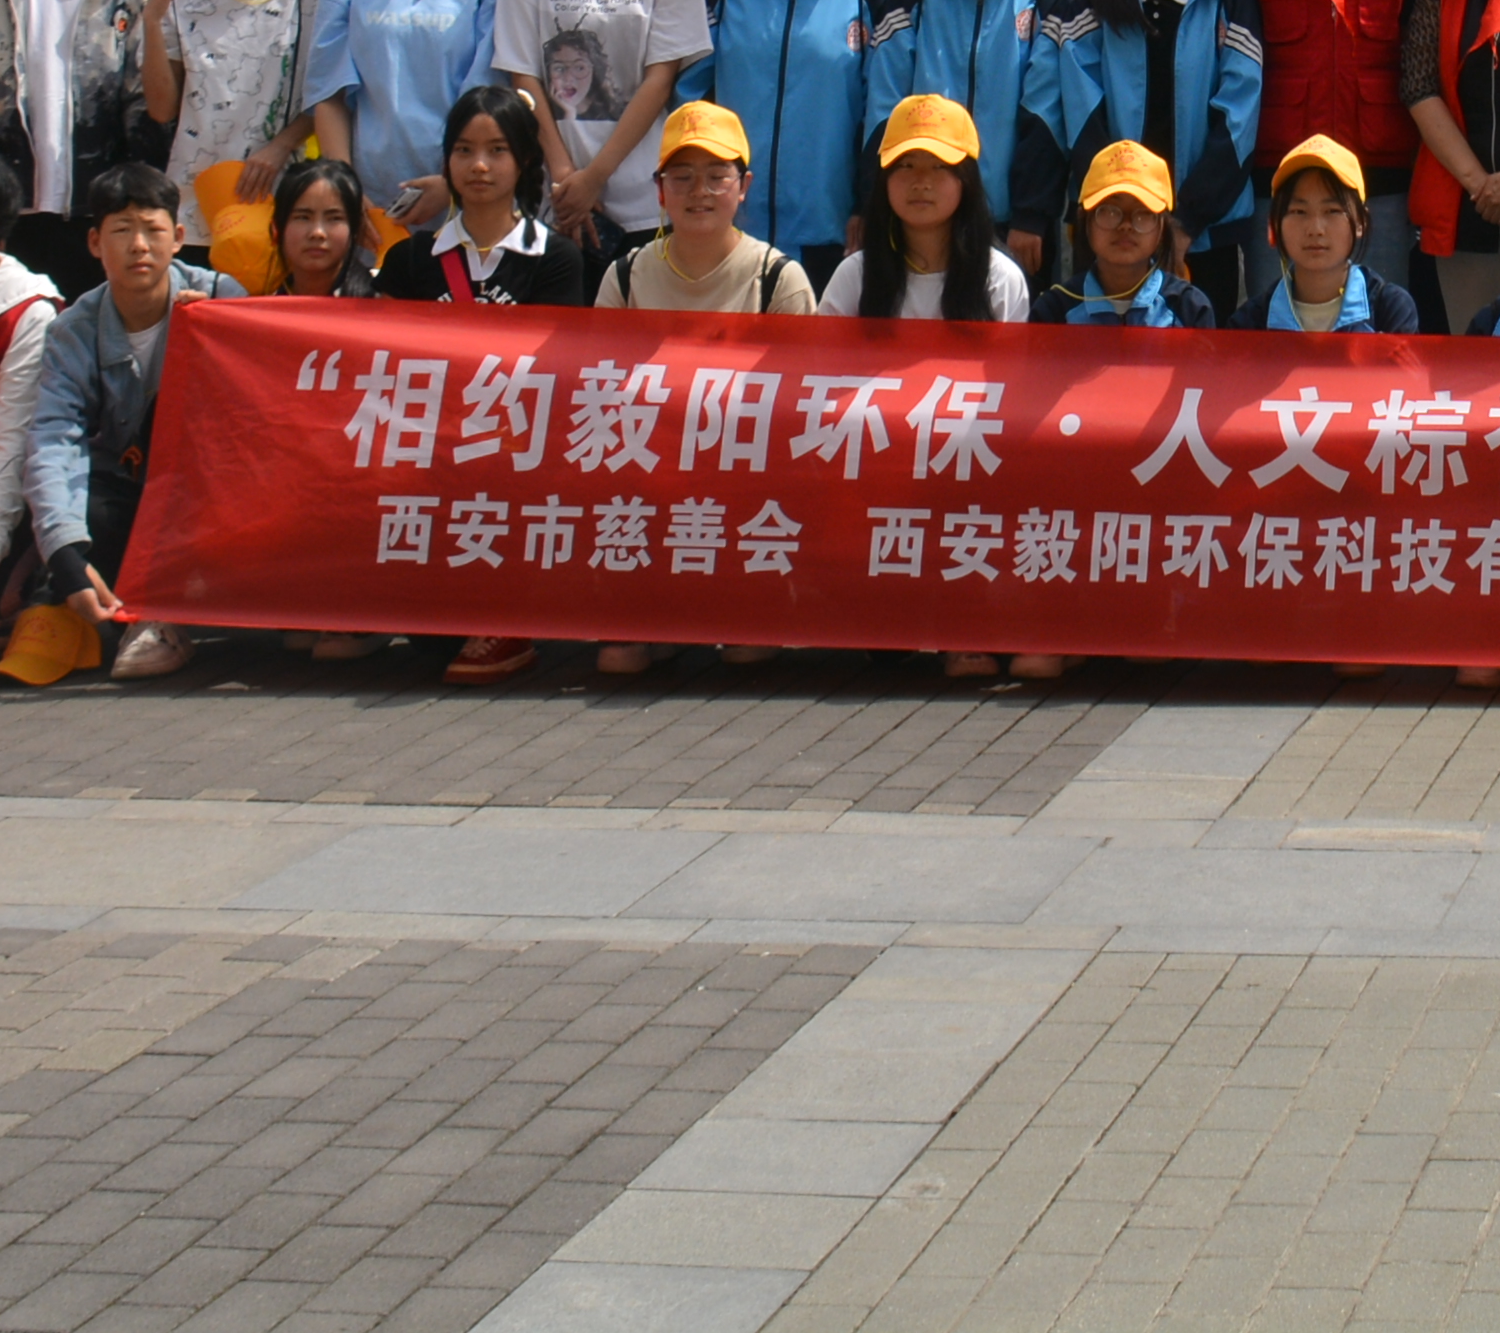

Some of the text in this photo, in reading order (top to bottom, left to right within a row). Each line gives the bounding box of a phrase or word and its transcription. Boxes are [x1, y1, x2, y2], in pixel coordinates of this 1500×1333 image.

[365, 7, 457, 32] wassup
[375, 492, 802, 576] 西安市慈善会
